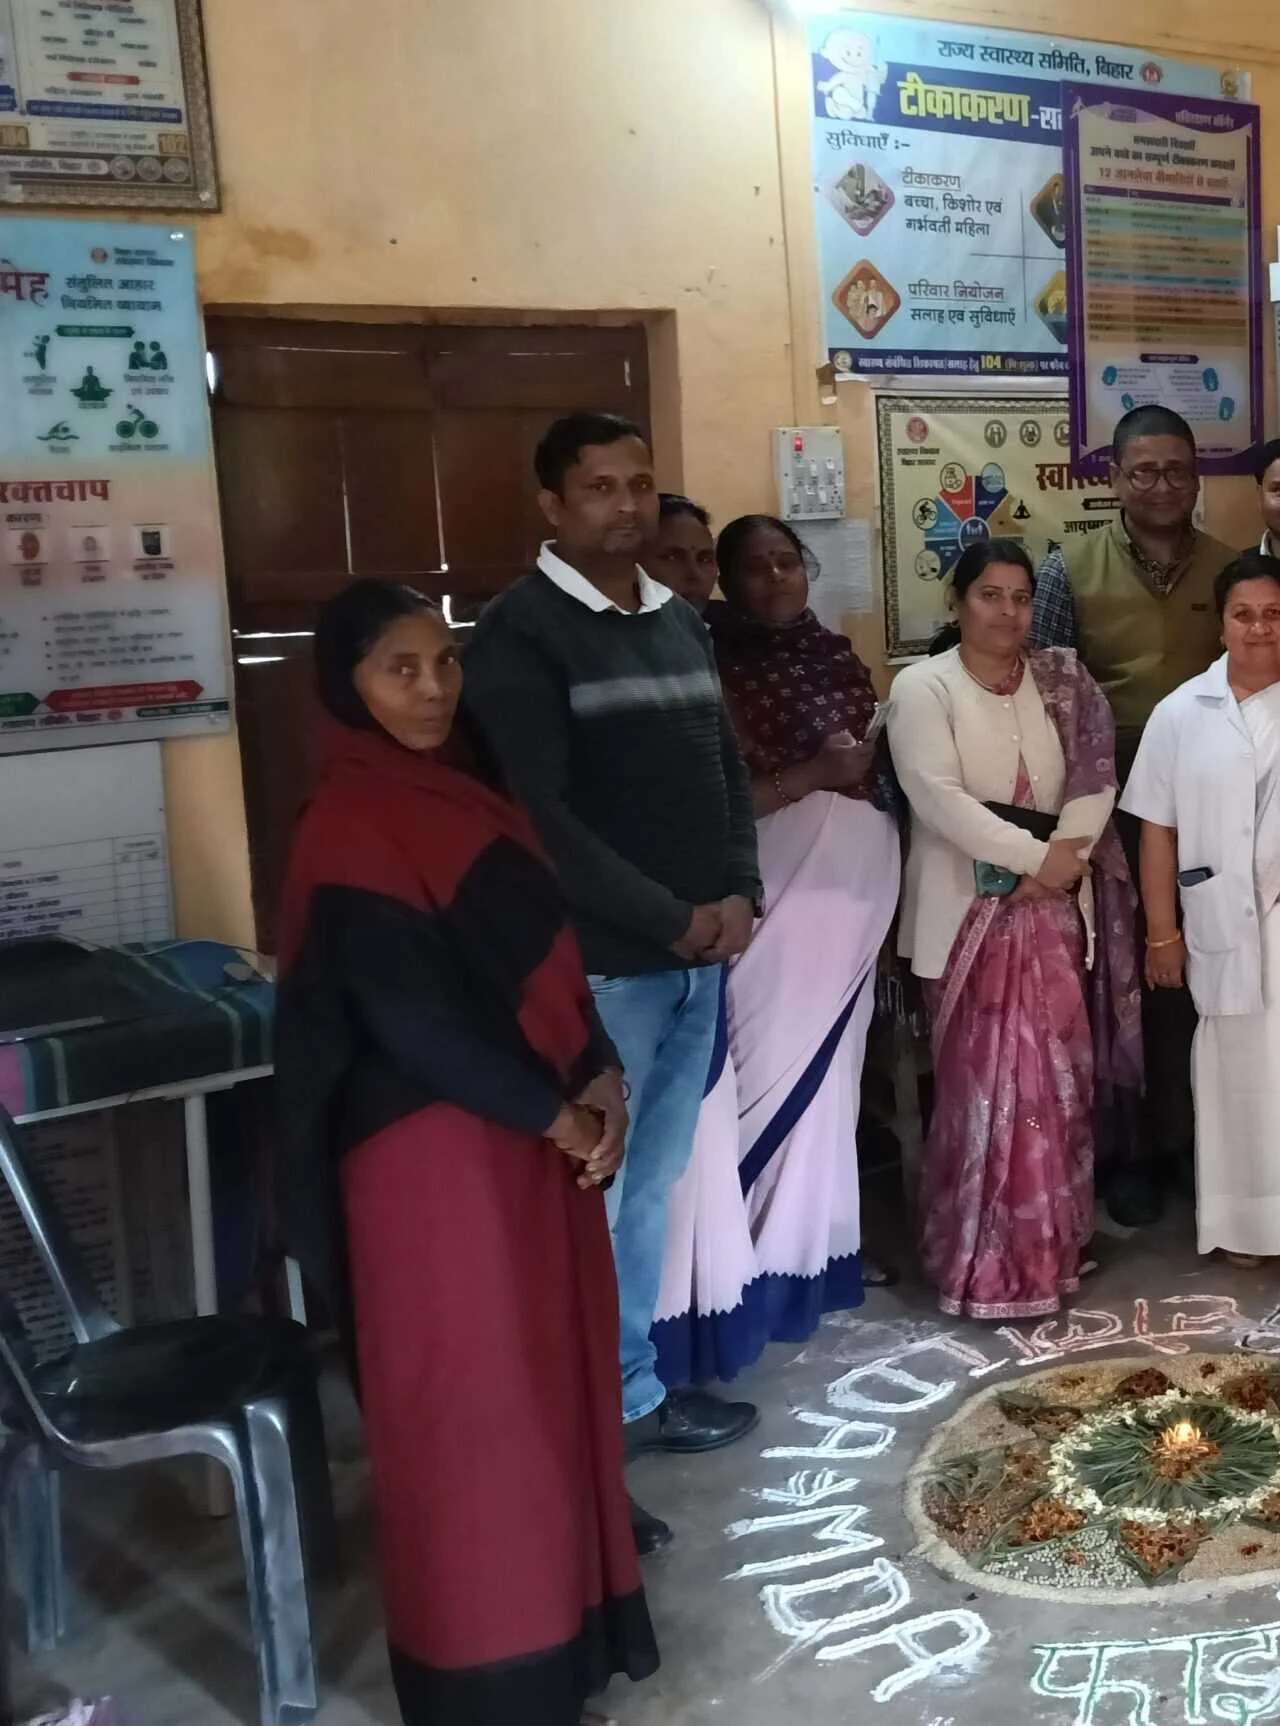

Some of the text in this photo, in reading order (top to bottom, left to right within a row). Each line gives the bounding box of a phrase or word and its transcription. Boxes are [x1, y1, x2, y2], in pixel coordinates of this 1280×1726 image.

[938, 40, 1134, 81] राज्य स्वास्थ्य समिति, बिहार
[826, 130, 890, 150] सुविधाएँ
[901, 166, 962, 189] टीकाकरण
[942, 194, 981, 213] किशोर
[985, 198, 1003, 216] एवं
[905, 216, 990, 238] गर्भवती महिला
[907, 279, 1005, 300] परिवार नियोजन
[910, 307, 945, 324] सलाह
[969, 307, 1016, 329] सुविधाएँ
[980, 355, 1001, 370] 104
[720, 1504, 991, 1704] MDA
